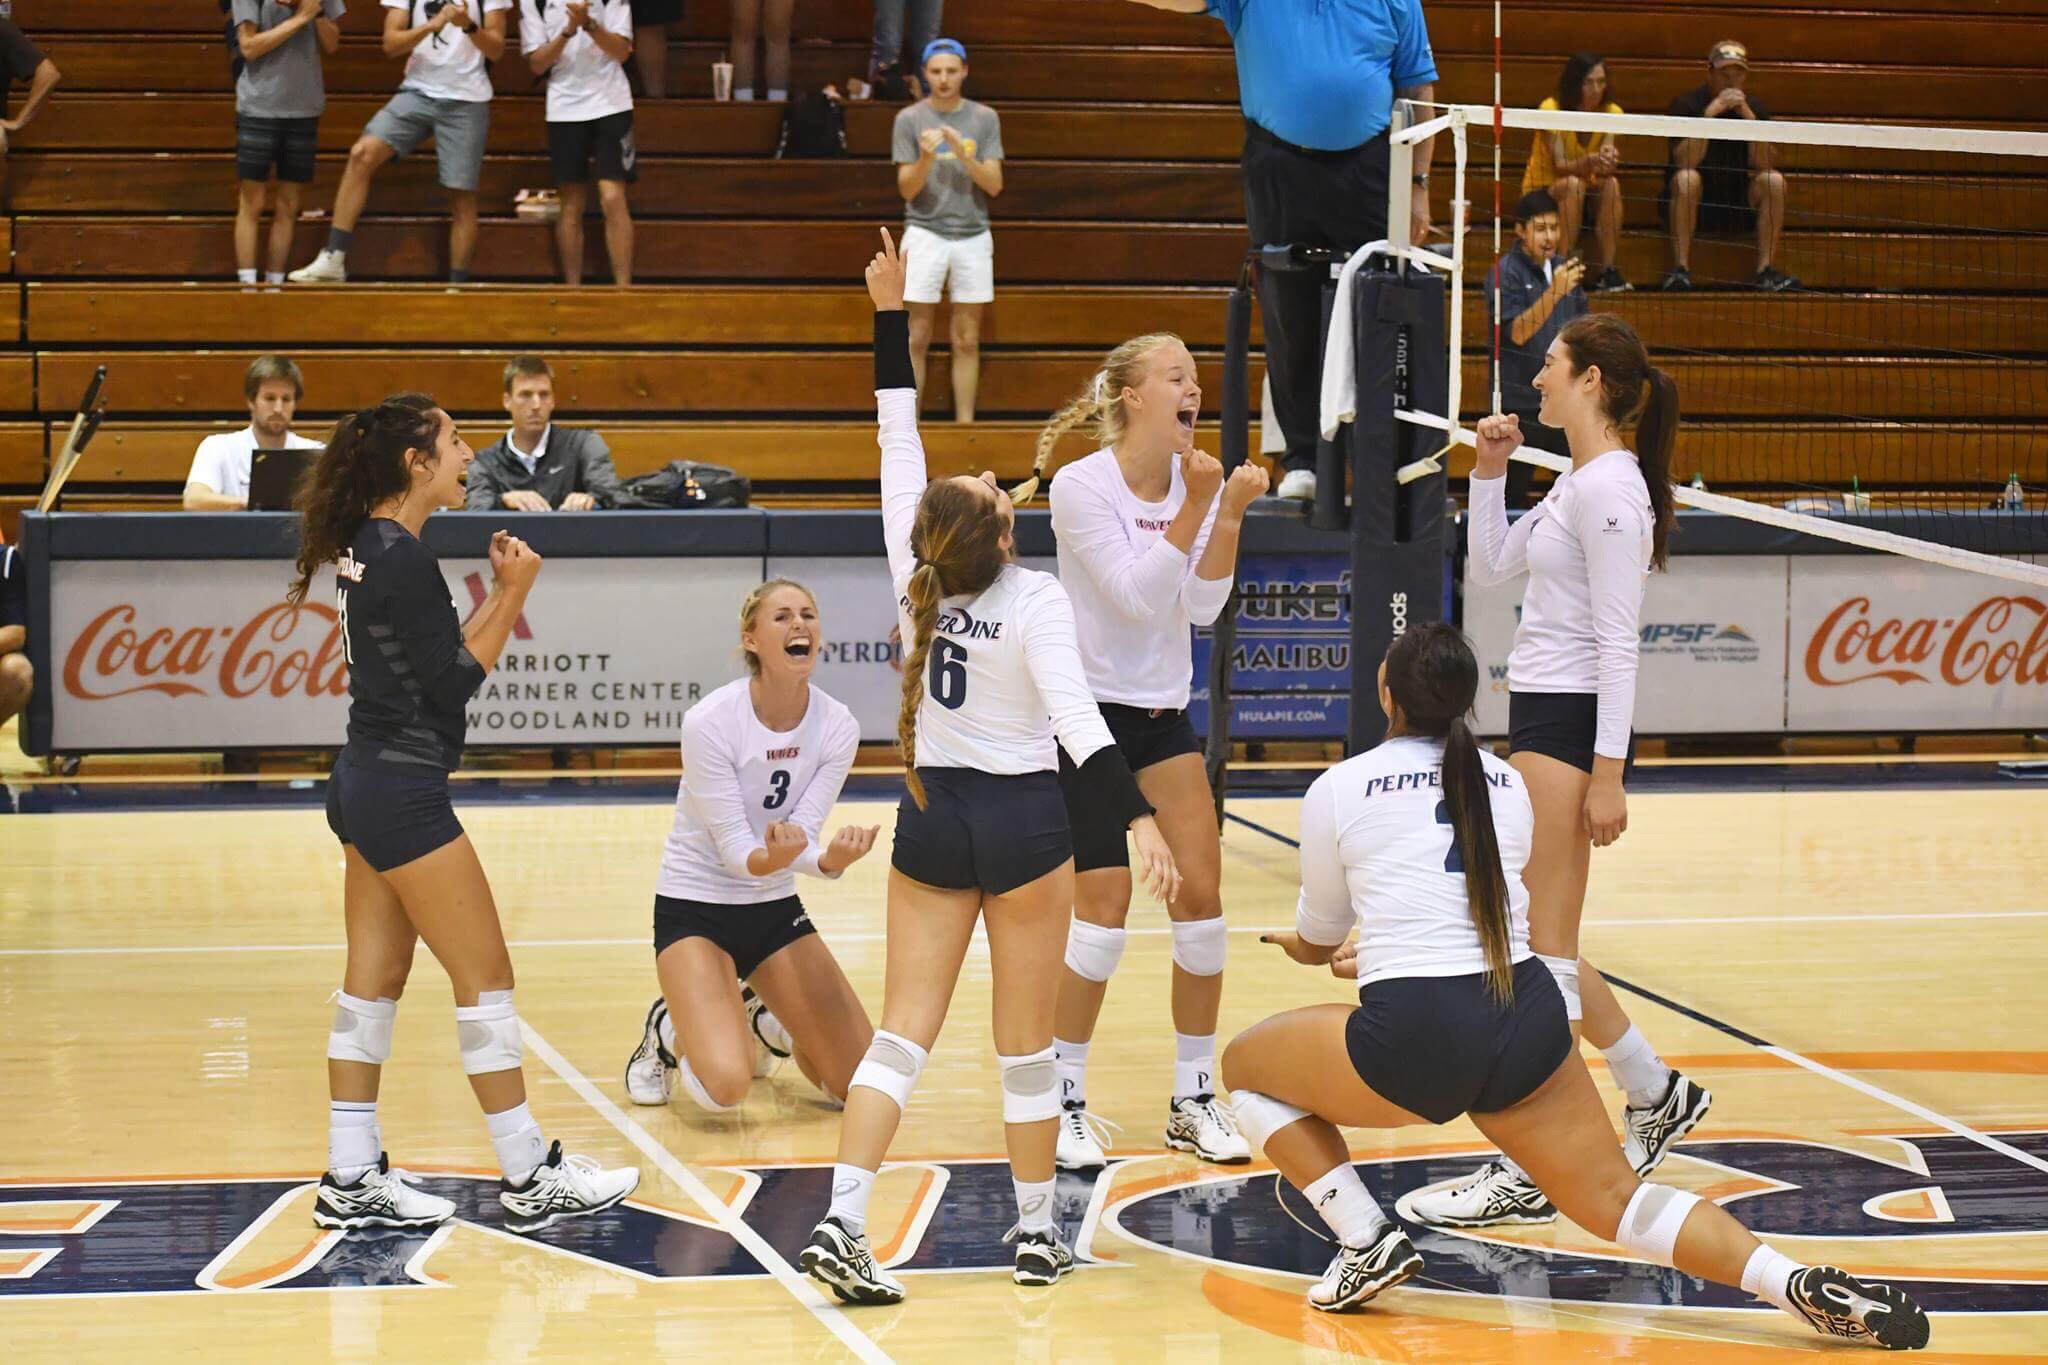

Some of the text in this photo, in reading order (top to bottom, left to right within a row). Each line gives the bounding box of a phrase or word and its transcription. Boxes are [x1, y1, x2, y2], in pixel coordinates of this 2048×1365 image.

[1235, 581, 1350, 621] UKE
[493, 654, 611, 673] RRIOTT
[929, 635, 968, 711] 6
[473, 682, 702, 701] ARNER CENTER
[763, 770, 791, 810] 3
[1365, 770, 1513, 798] PEPPENE
[1197, 1071, 1209, 1089] P
